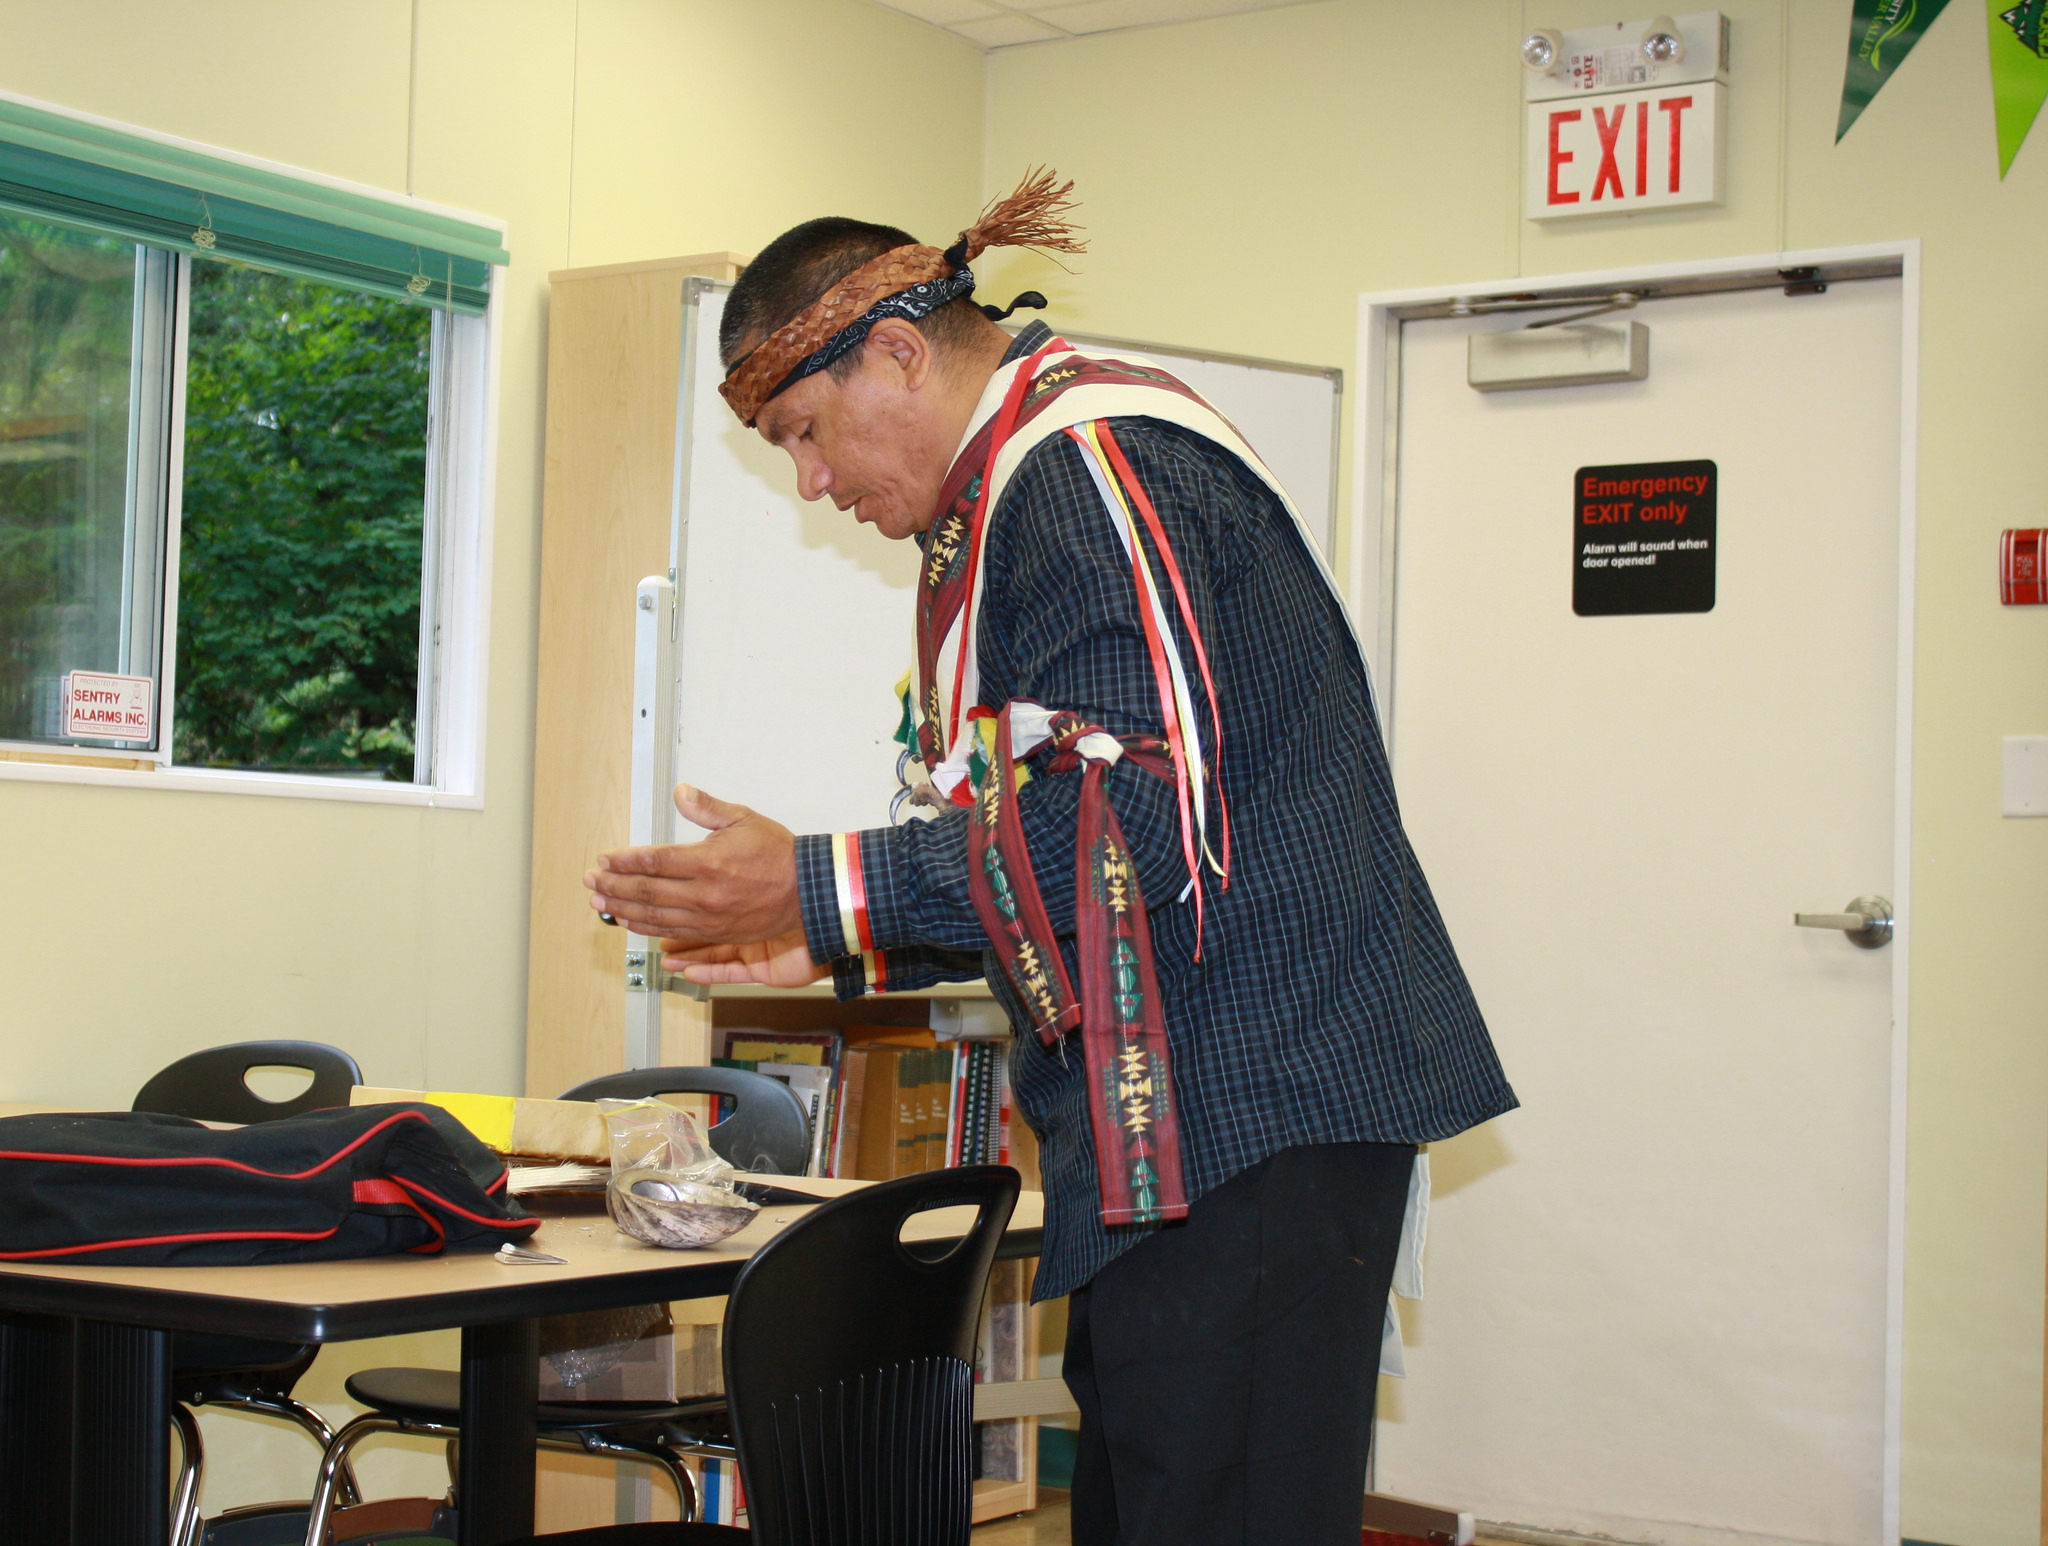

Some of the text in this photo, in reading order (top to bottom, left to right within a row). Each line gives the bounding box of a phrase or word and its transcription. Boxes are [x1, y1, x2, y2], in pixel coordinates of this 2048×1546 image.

[1858, 16, 1884, 61] VALLEY
[1584, 55, 1594, 90] ELITE
[1547, 95, 1693, 206] EXIT
[1583, 474, 1709, 499] Emergency
[1582, 500, 1688, 525] EXIT only
[1582, 538, 1708, 555] Alarm will sound when
[1582, 554, 1656, 569] door opened!
[73, 689, 120, 704] SENTRY
[73, 708, 147, 725] ALARMS INC.
